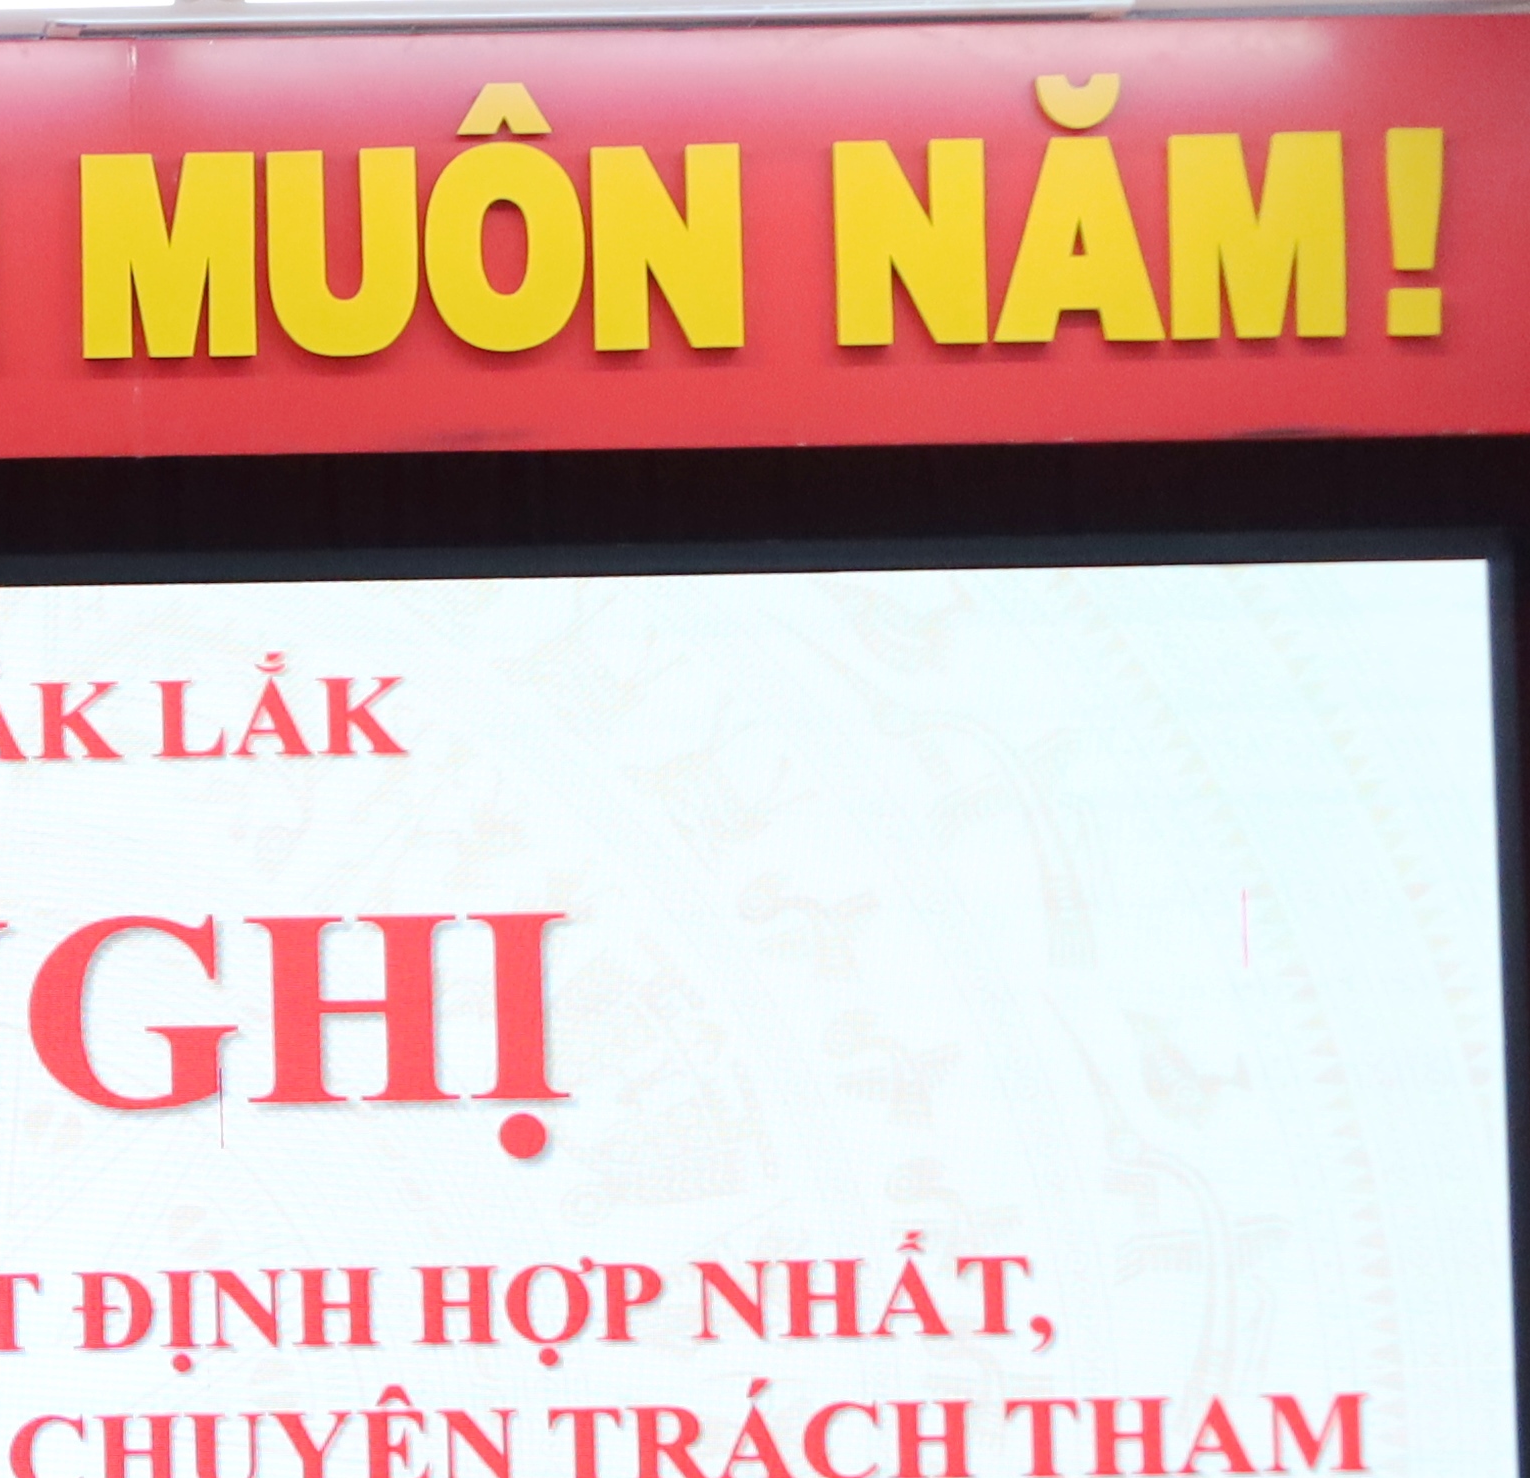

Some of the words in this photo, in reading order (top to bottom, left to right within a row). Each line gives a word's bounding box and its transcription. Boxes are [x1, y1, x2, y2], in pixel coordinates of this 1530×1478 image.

[81, 83, 745, 358] MUÔN
[158, 653, 405, 759] LẮK
[75, 1268, 377, 1373] ĐỊNH
[419, 1257, 662, 1366] HỢP
[695, 1231, 1053, 1346] NHẤT,
[1005, 1393, 1365, 1478] THAM
